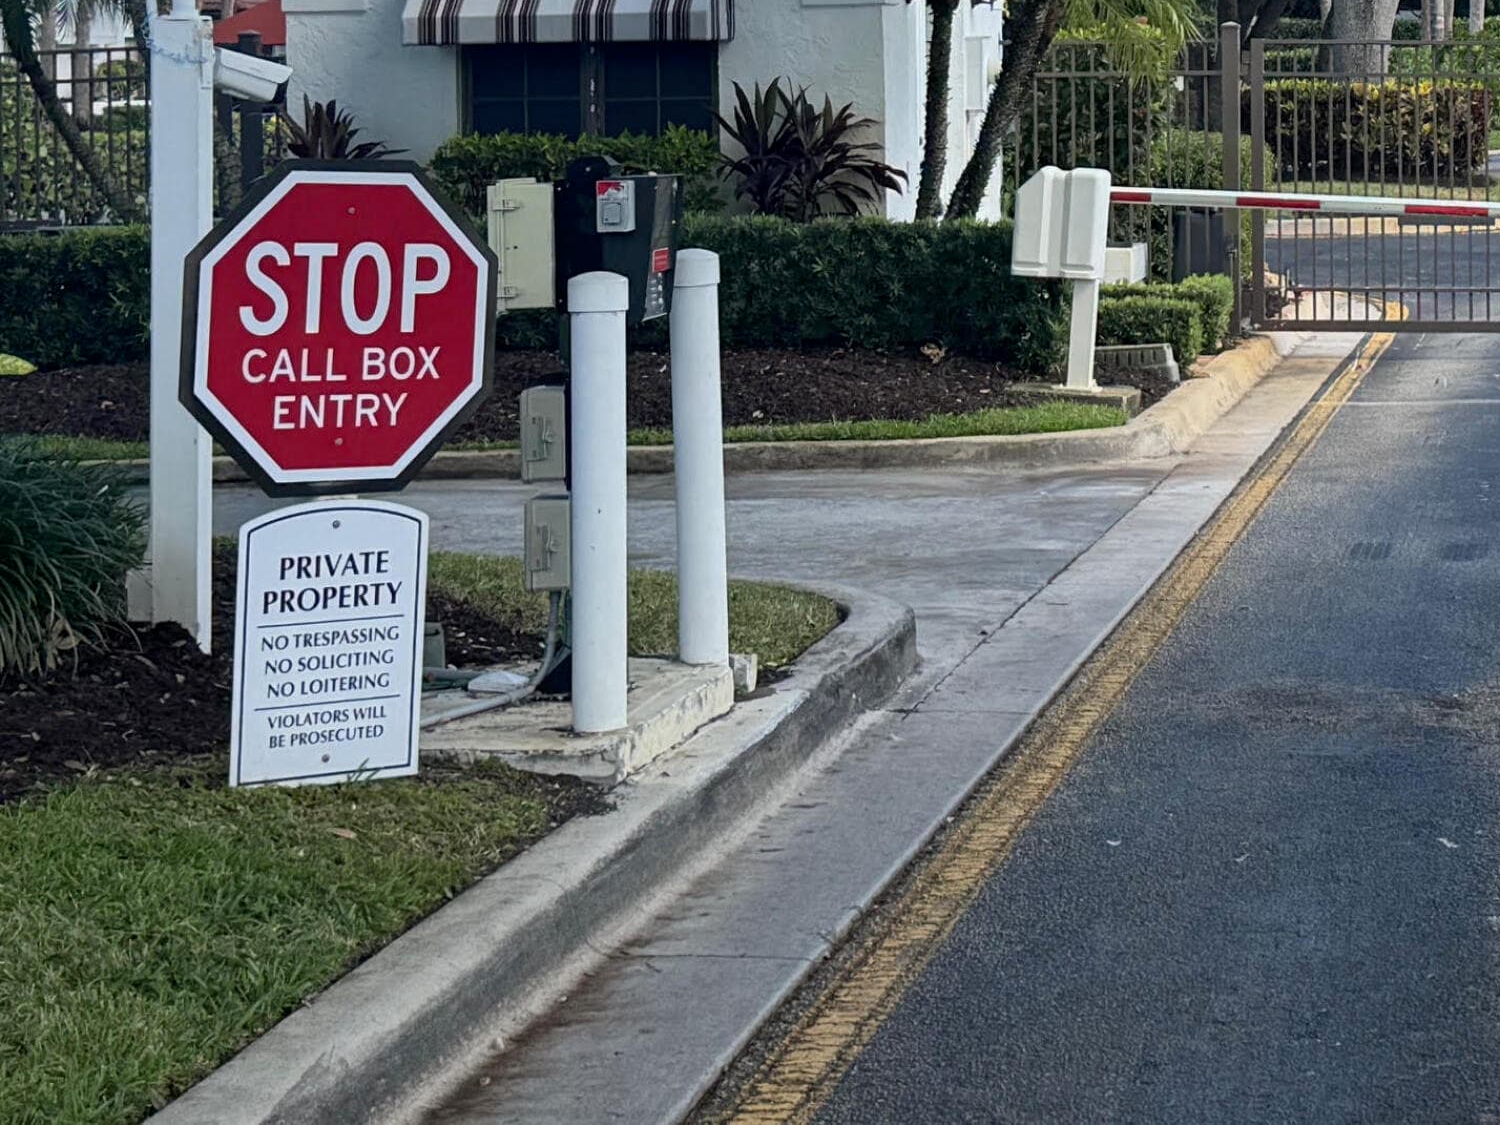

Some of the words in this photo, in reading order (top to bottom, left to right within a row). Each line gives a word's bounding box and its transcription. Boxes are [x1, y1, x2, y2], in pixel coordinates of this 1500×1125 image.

[239, 241, 450, 336] STOP
[242, 348, 347, 383] CALL
[362, 346, 441, 381] BOX
[273, 392, 408, 430] ENTRY
[279, 550, 389, 581] PRIVATE
[263, 581, 403, 614] PROPERTY
[261, 635, 289, 651] NO
[293, 626, 399, 649] TRESPASSING
[265, 658, 293, 675] NO
[297, 649, 394, 672] SOLICITING
[267, 682, 295, 699] NO
[300, 673, 390, 695] LOITERING
[267, 708, 349, 729] VIOLATORS
[353, 705, 387, 721] WILL
[269, 735, 286, 749] BE
[290, 724, 384, 746] PROSECUTED
